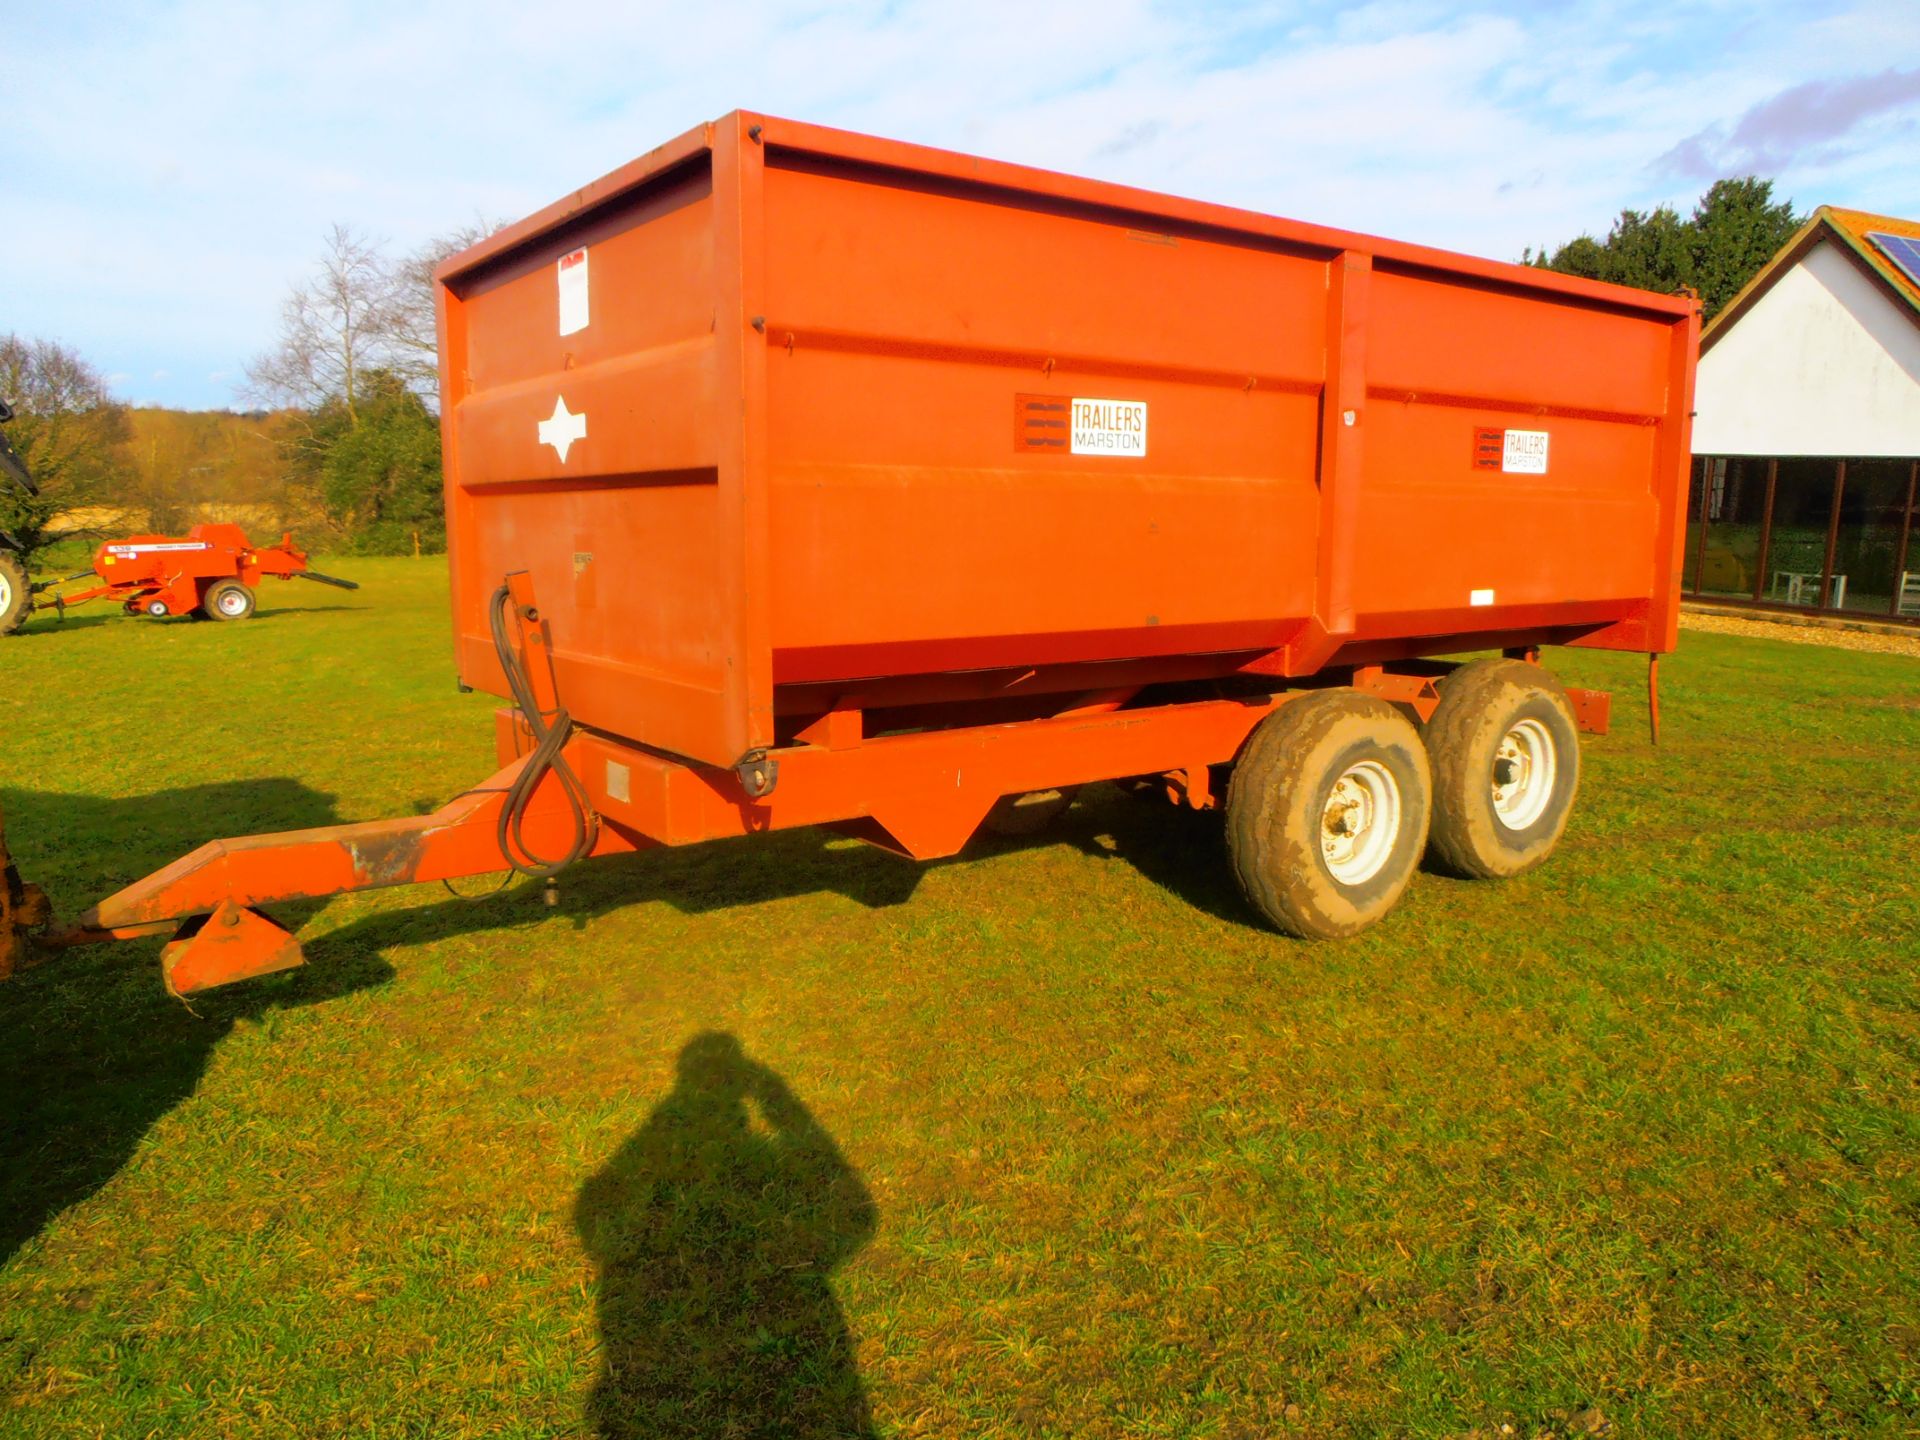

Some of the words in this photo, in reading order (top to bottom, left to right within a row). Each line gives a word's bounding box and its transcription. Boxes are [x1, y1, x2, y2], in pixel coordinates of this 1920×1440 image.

[1073, 403, 1142, 432] TRAILERS
[1074, 432, 1140, 449] MARSTON
[1506, 433, 1545, 455] TRAILERS
